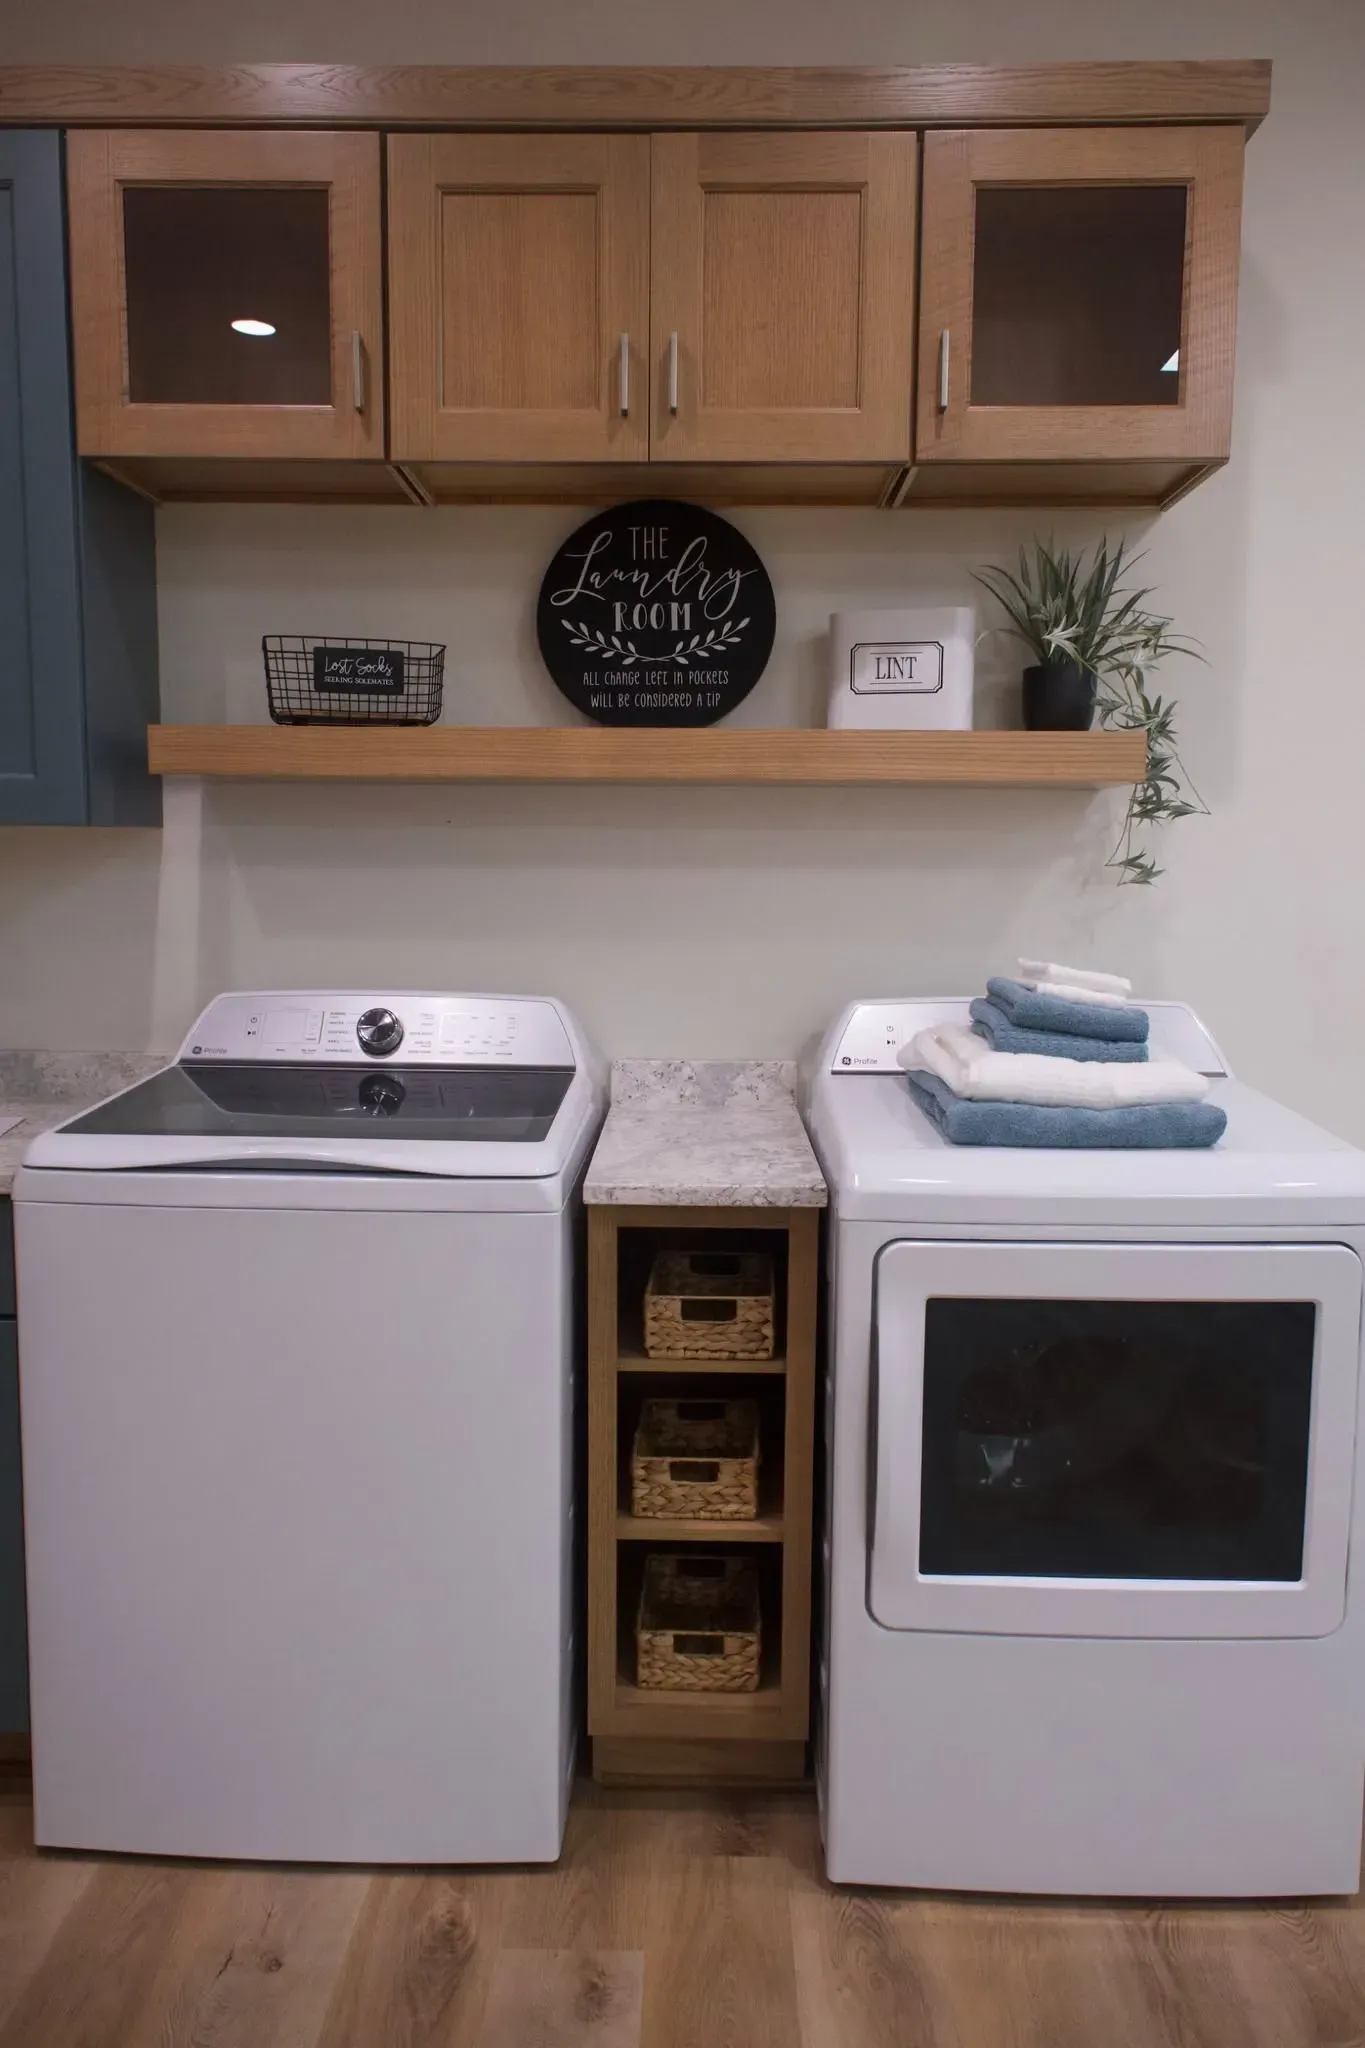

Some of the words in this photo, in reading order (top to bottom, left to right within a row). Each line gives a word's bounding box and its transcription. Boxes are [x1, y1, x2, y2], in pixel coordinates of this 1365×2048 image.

[628, 527, 669, 560] THE
[550, 531, 759, 620] Laundry
[612, 601, 693, 632] ROOM
[324, 656, 354, 675] Lost
[356, 656, 394, 677] Socks
[874, 656, 917, 680] LINT
[324, 675, 353, 684] SEEKING
[583, 671, 600, 686] ALL
[696, 693, 703, 707] A
[853, 1057, 878, 1065] Profile
